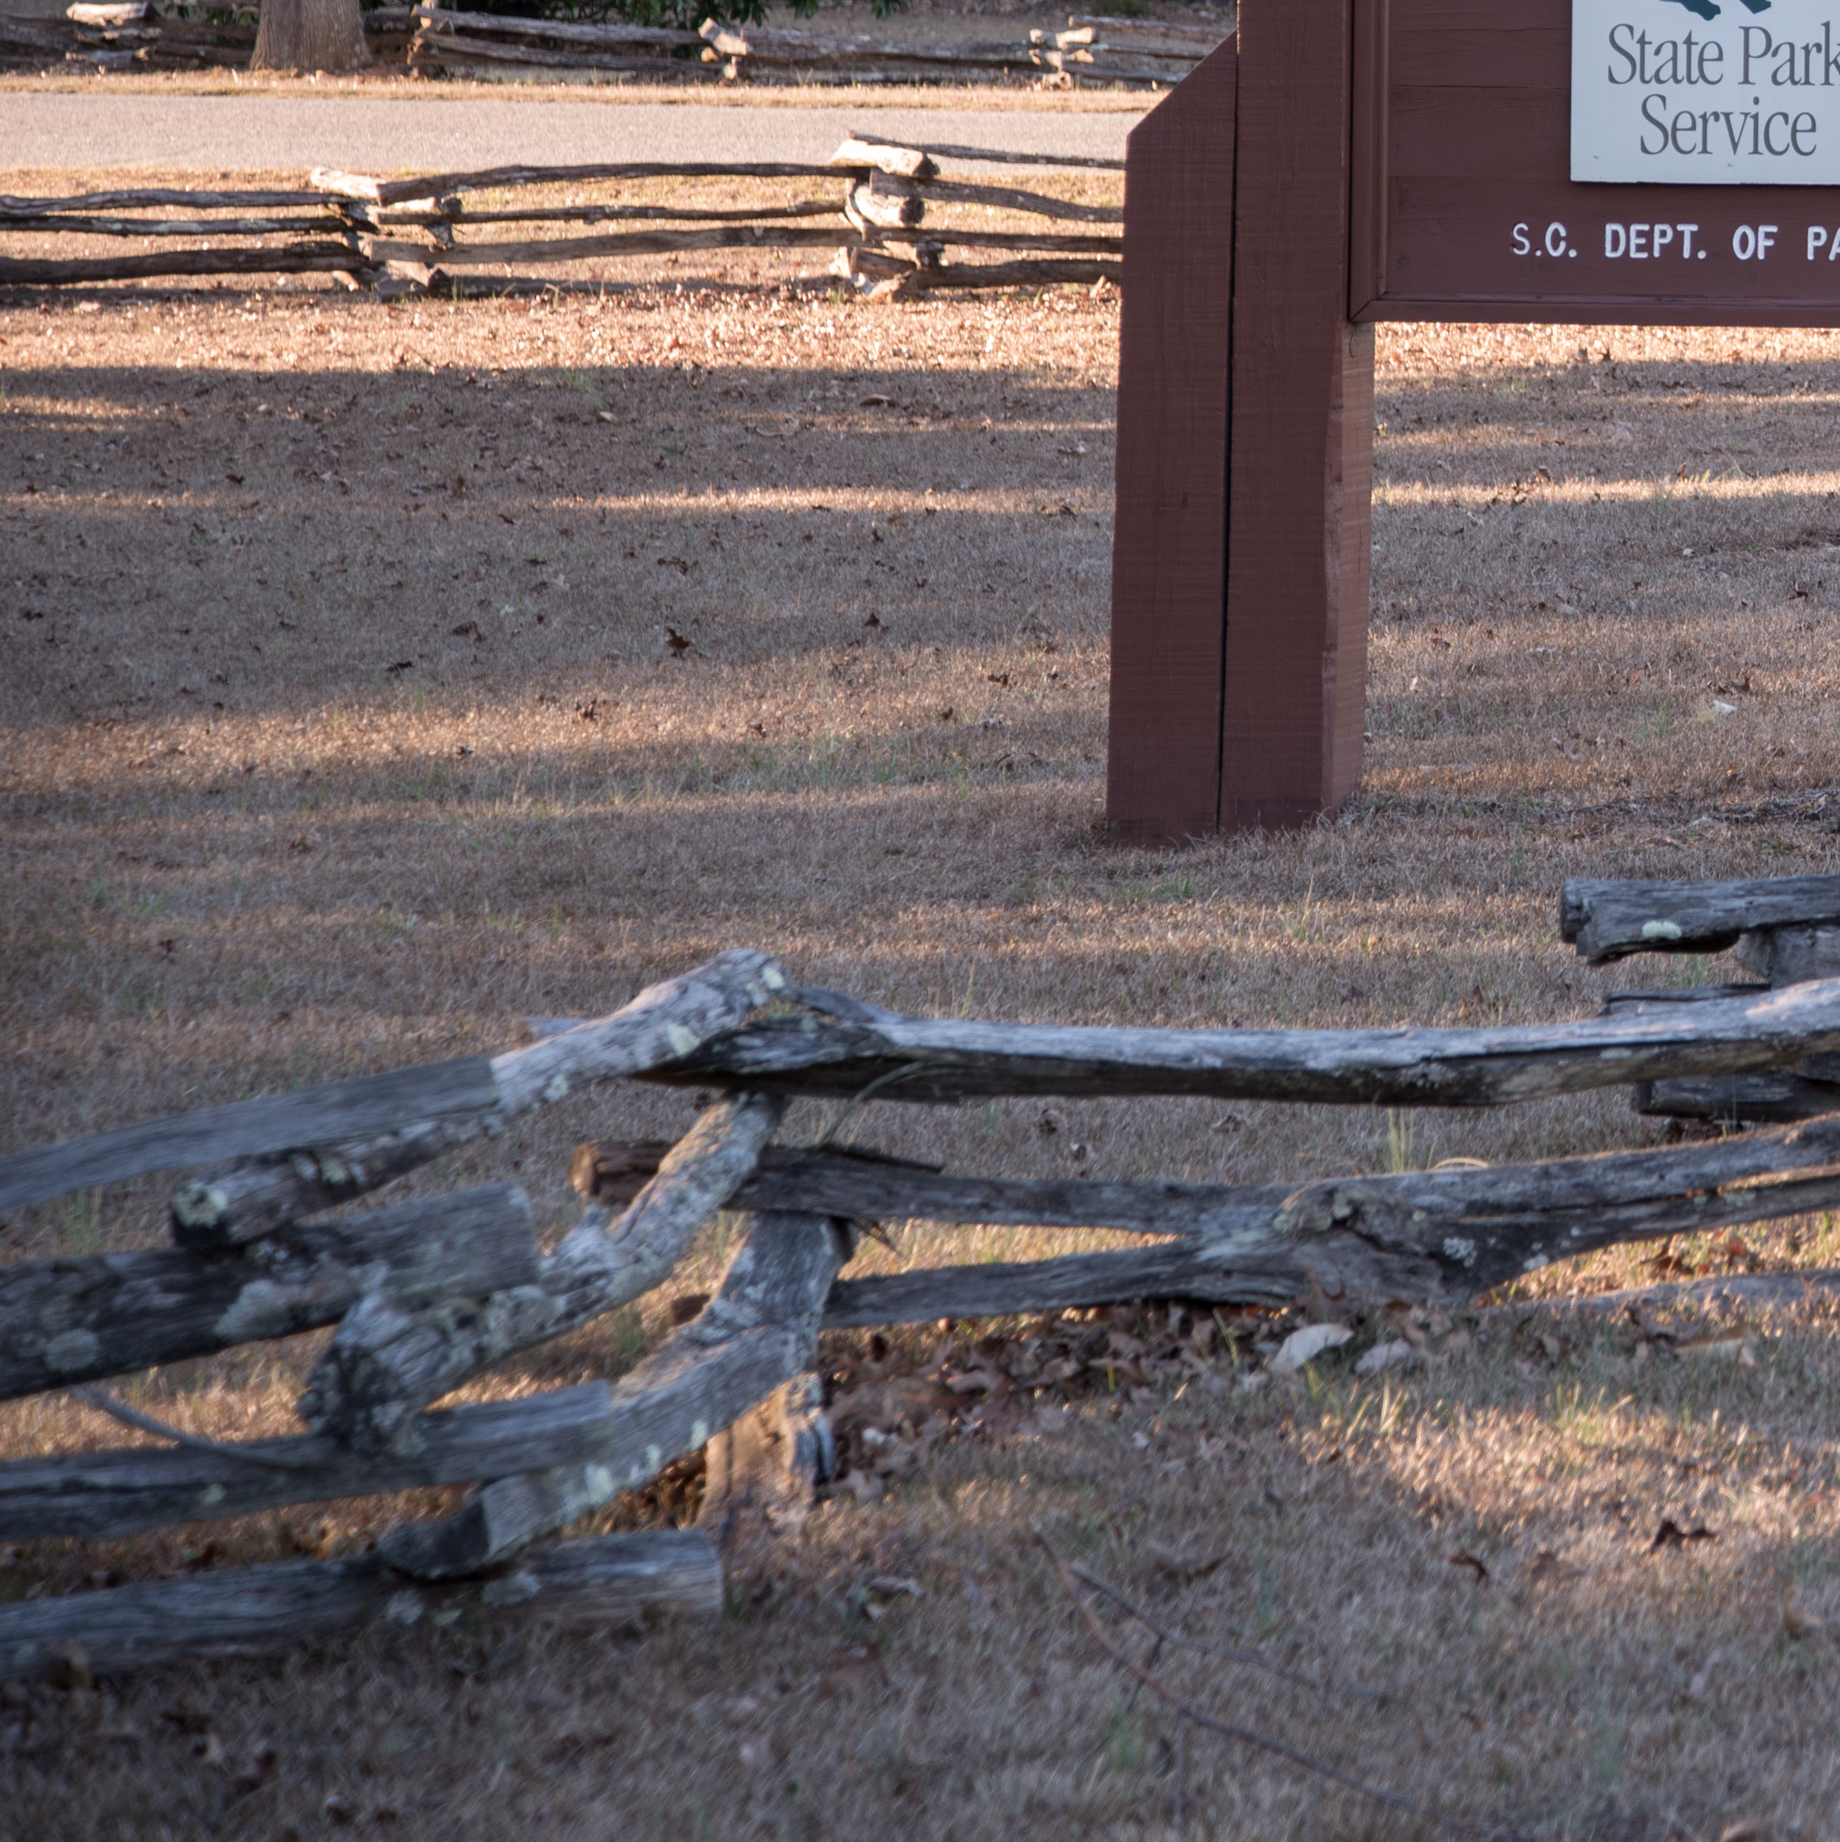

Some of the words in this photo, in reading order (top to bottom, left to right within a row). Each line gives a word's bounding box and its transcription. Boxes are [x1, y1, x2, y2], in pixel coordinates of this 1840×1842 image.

[1607, 23, 1724, 86] State
[1640, 93, 1817, 157] Service
[1512, 222, 1578, 258] S.C.
[1604, 223, 1707, 260] DEPT.
[1732, 224, 1778, 261] OF
